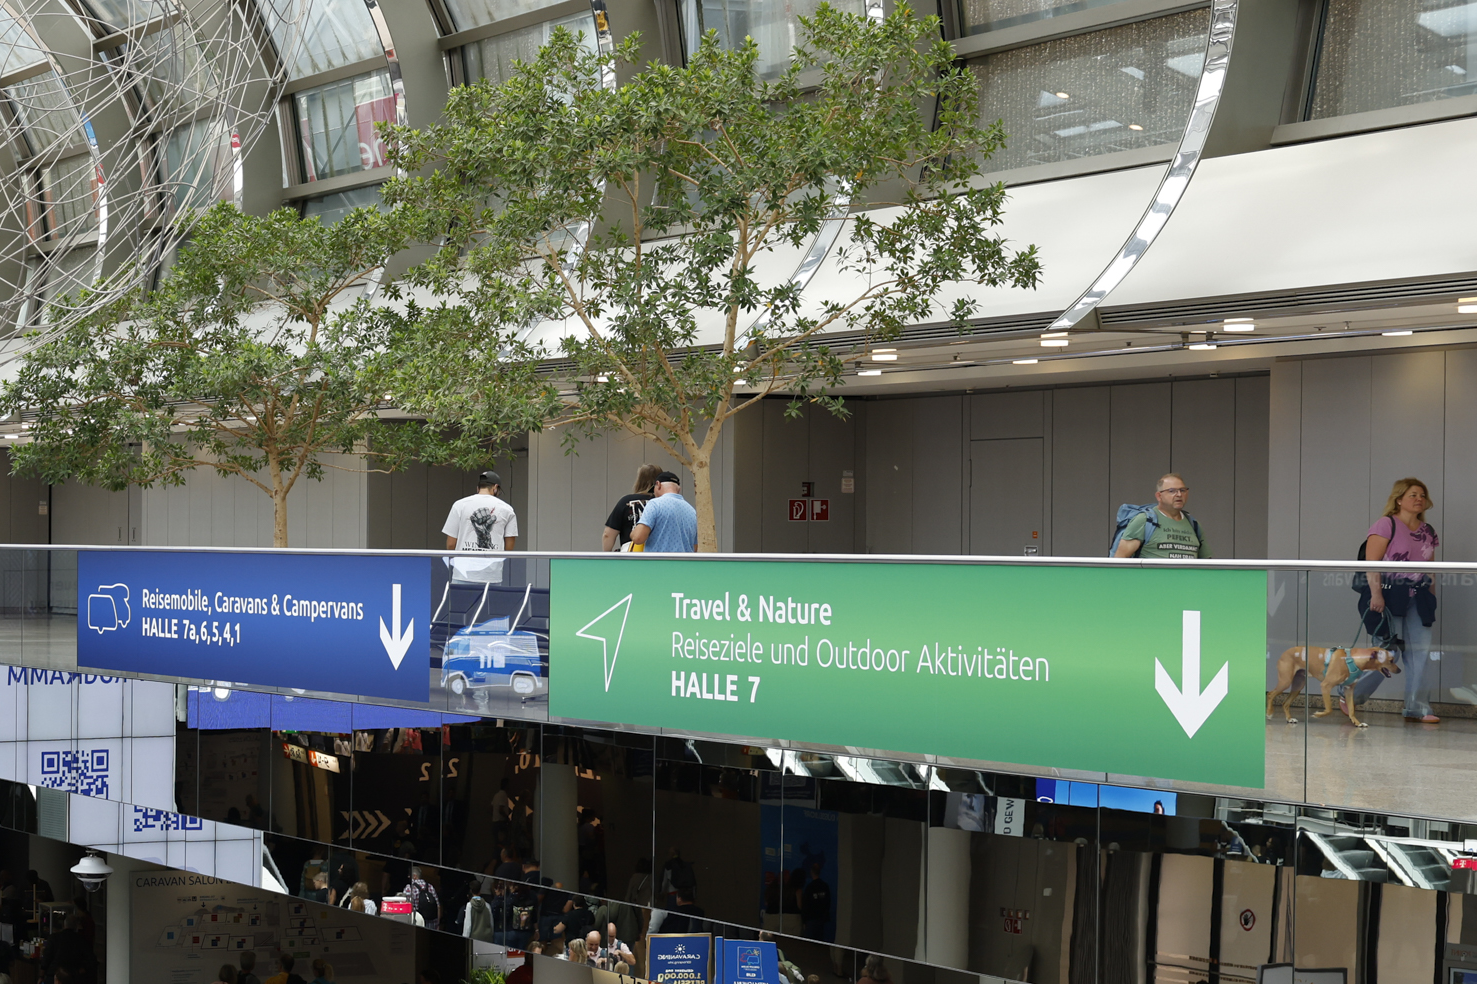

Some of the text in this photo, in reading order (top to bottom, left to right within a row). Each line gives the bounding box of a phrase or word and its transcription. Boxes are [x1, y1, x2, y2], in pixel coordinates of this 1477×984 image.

[142, 588, 364, 622] Reisemobile, Caravans & Campervans
[671, 592, 832, 626] Travel & Nature
[142, 617, 179, 639] HALLE
[671, 630, 1050, 683] Reiseziele und Outdoor Aktivitäten
[671, 671, 761, 703] HALLE 7
[136, 876, 186, 888] CARAVAN
